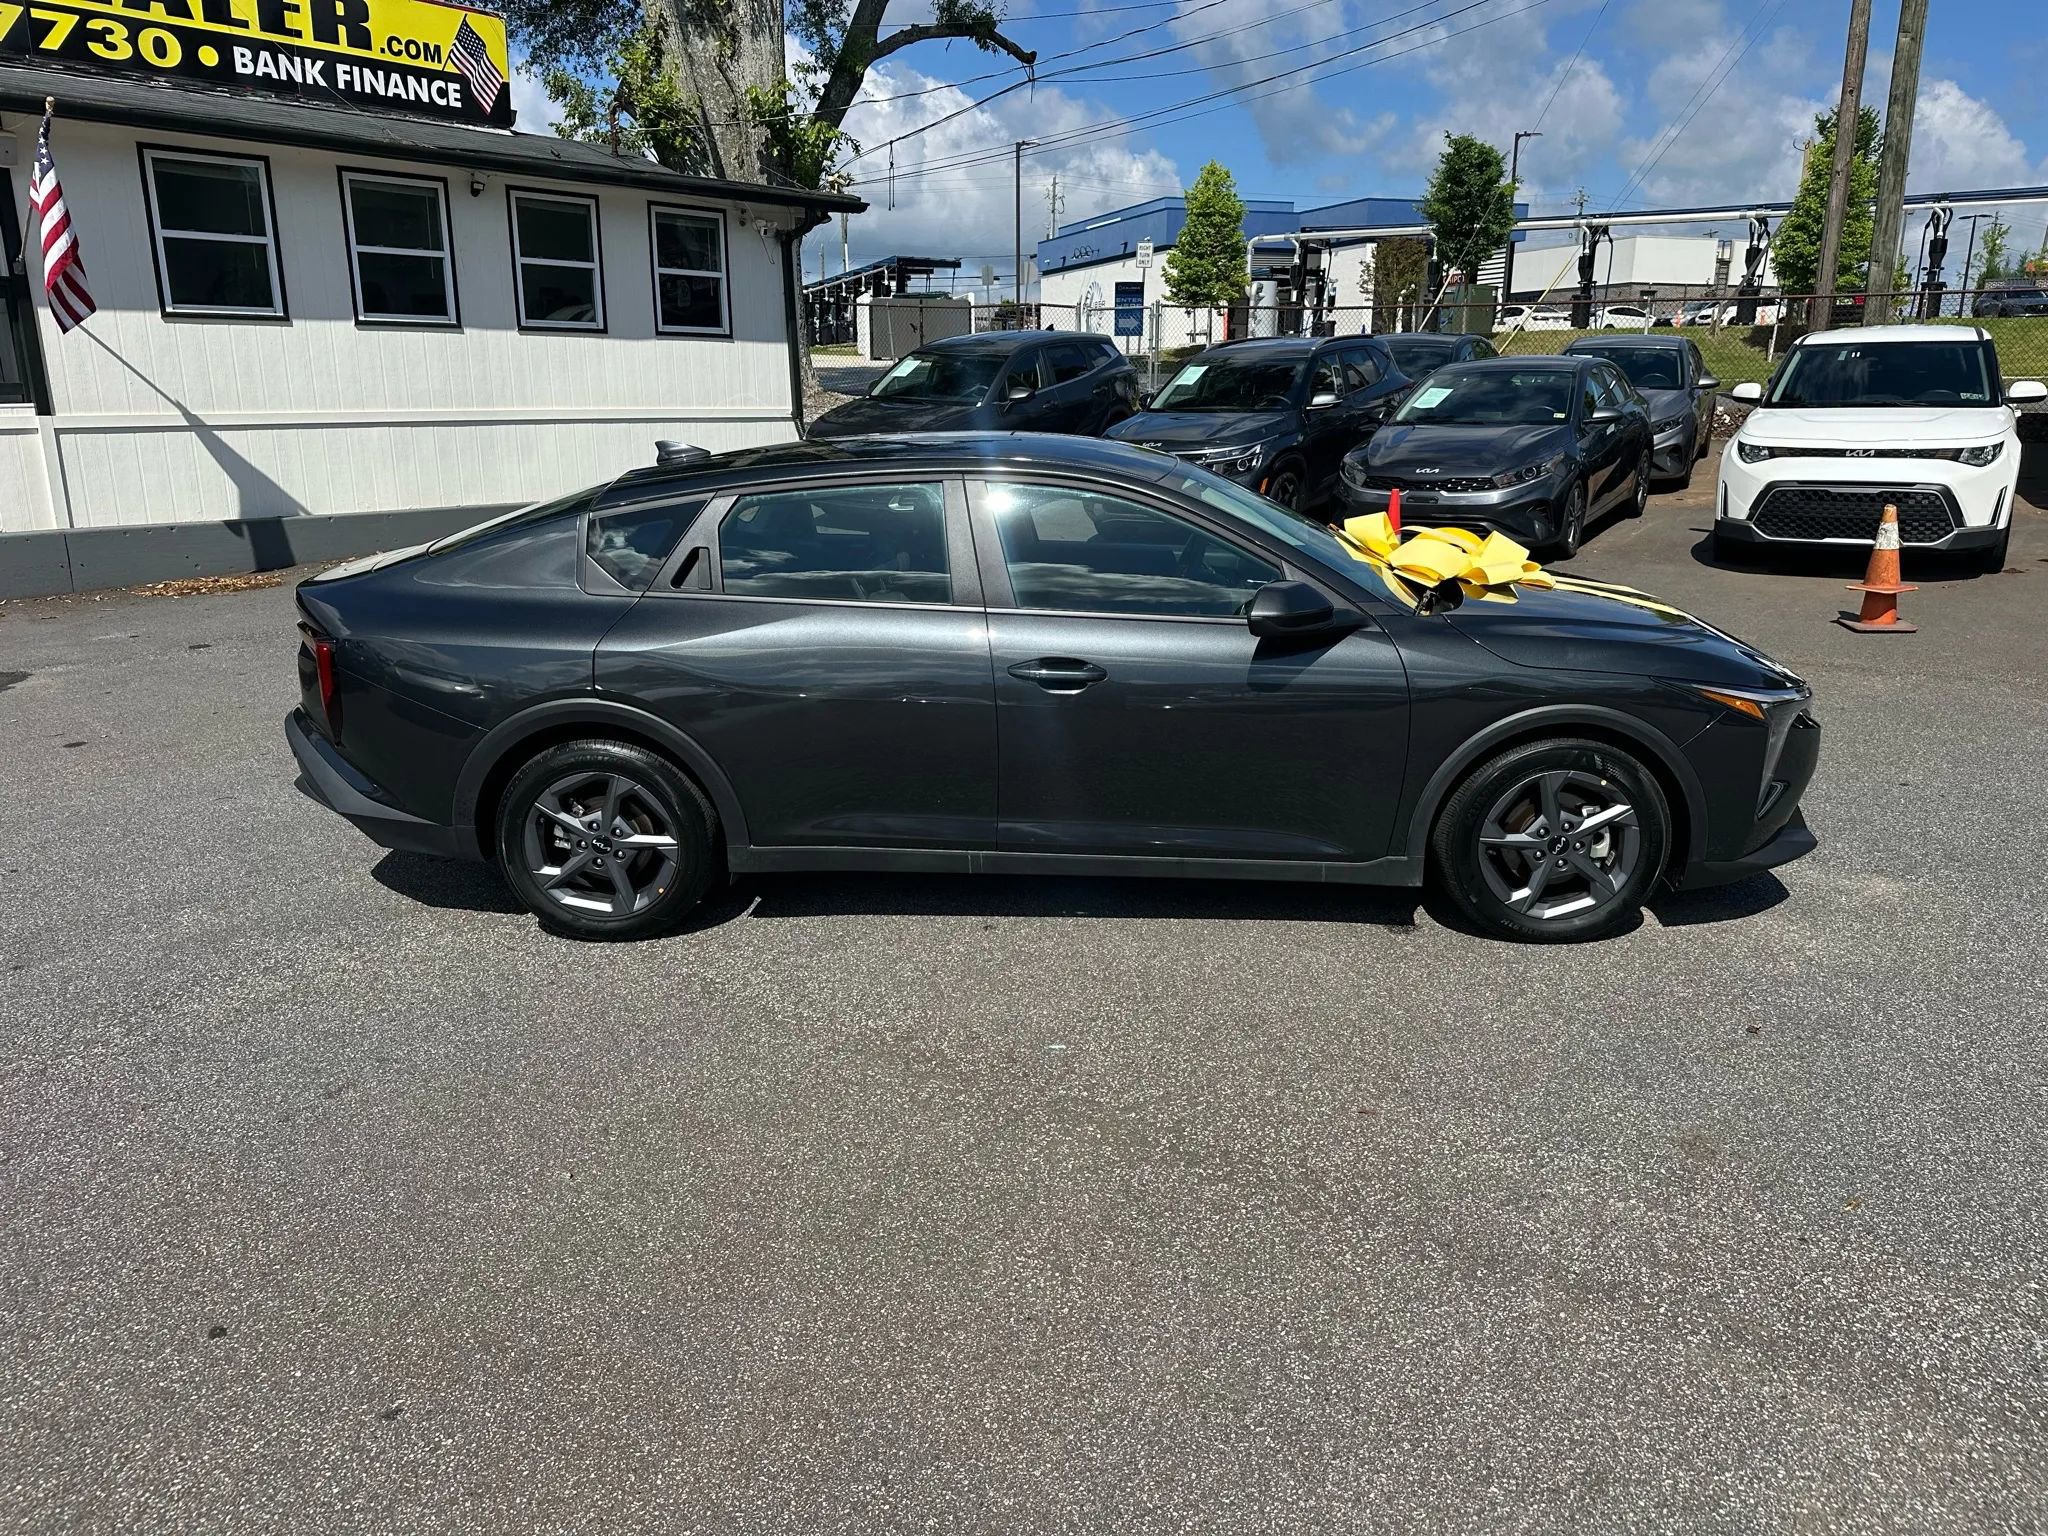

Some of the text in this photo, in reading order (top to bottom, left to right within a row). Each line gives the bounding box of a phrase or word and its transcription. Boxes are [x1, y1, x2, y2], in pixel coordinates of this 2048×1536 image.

[233, 45, 328, 88] BANK
[335, 62, 463, 108] FINANCE
[1845, 449, 1875, 457] KIA
